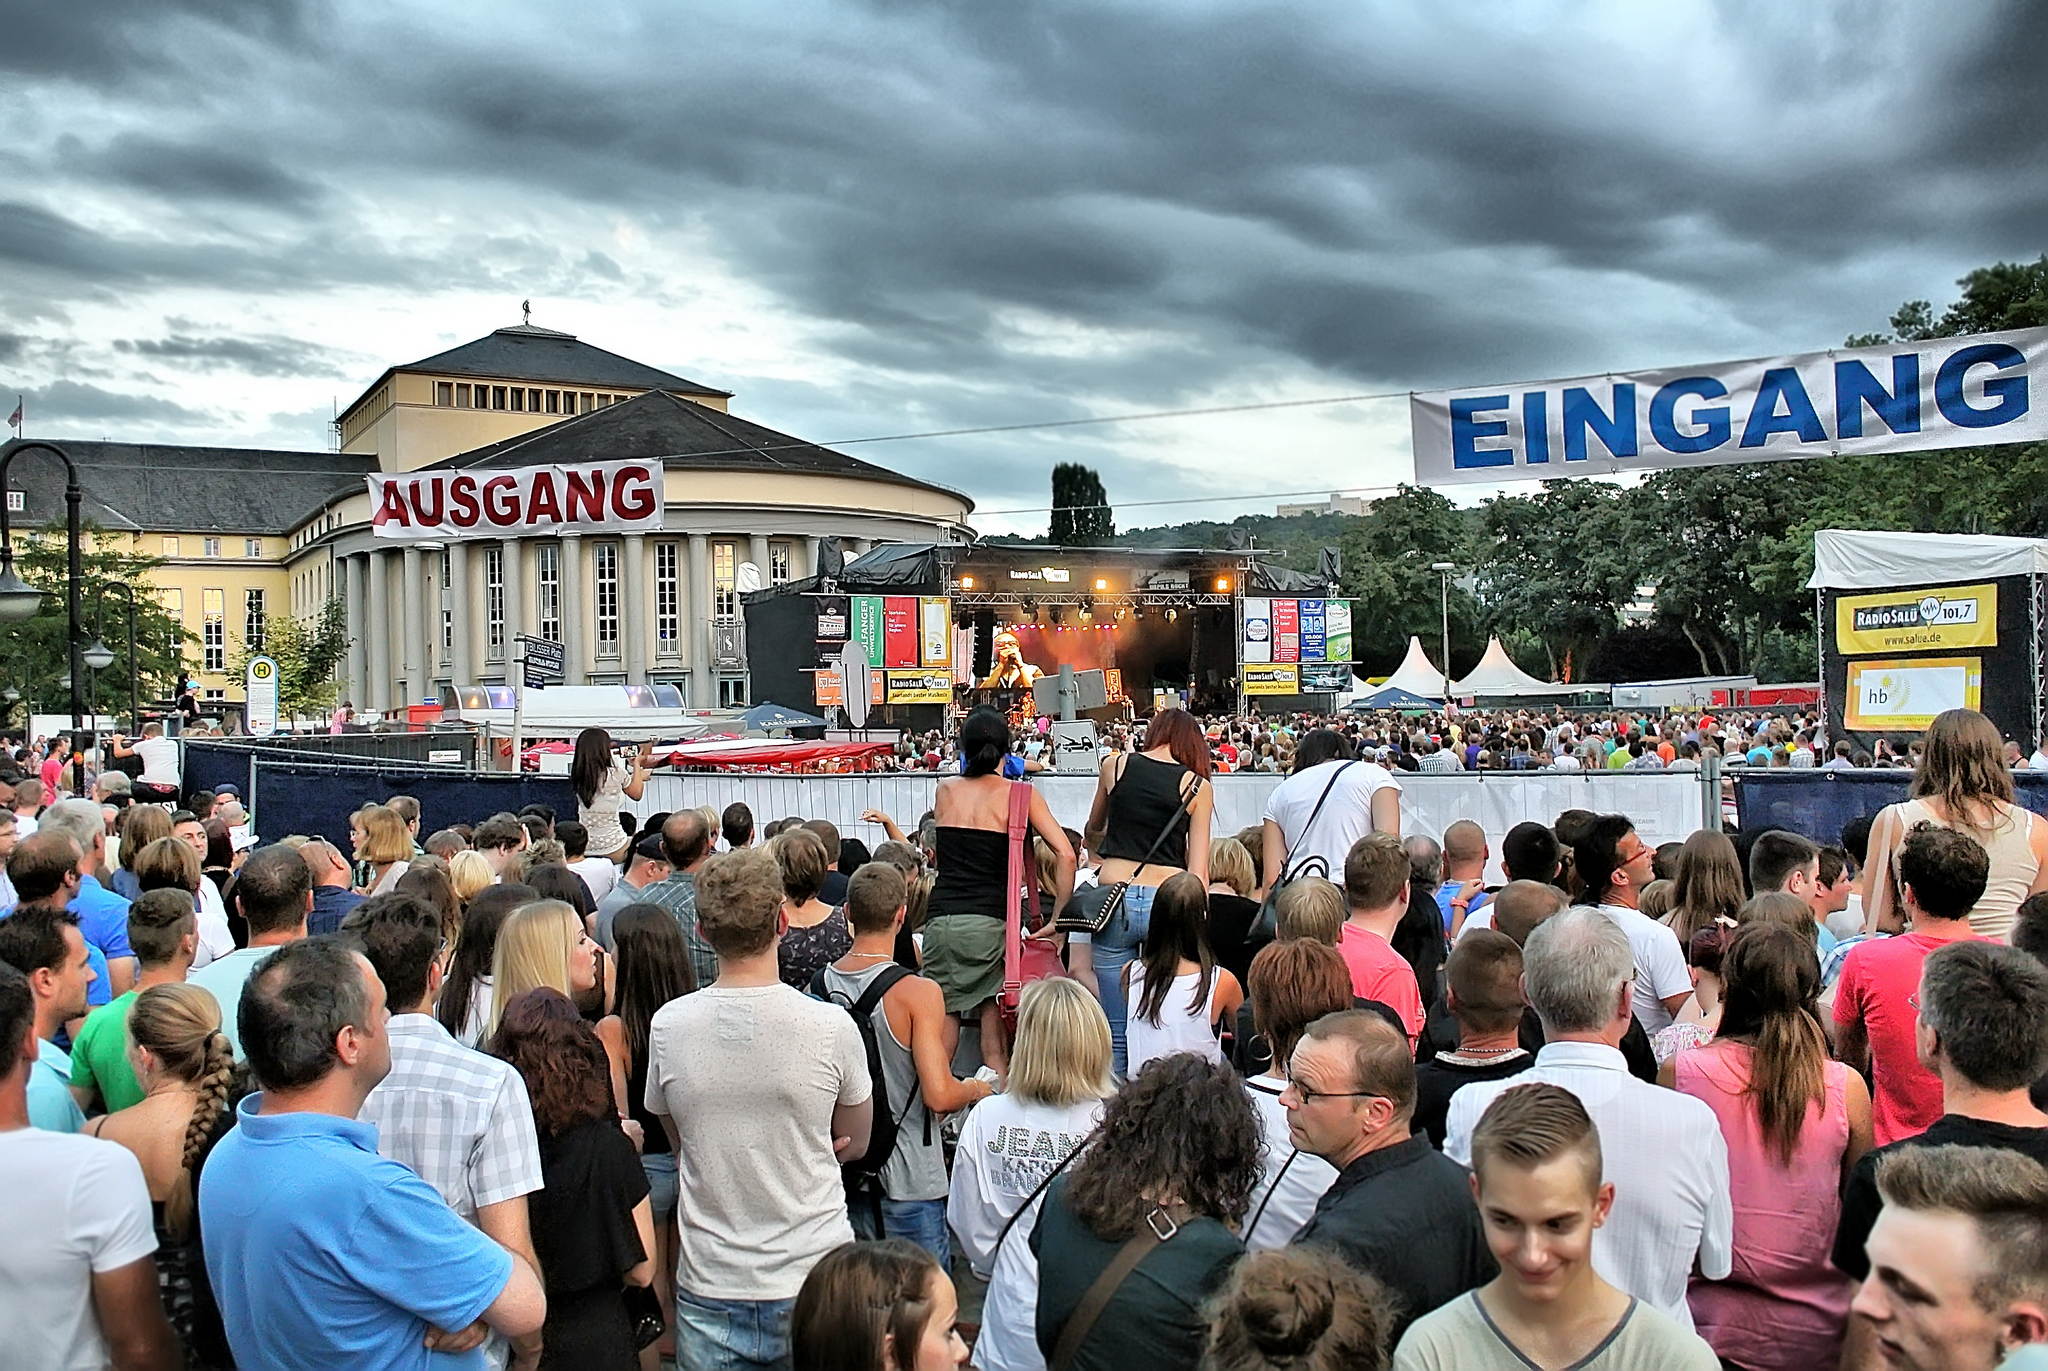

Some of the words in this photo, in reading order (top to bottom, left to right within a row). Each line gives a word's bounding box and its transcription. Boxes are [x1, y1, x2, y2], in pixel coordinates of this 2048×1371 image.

[1449, 343, 2030, 470] EINGANG
[372, 466, 656, 527] AUSGANG
[1943, 604, 1972, 620] 101,7
[1884, 632, 1941, 646] www.salue.de
[934, 643, 942, 655] hb
[257, 665, 267, 675] H
[1869, 688, 1888, 704] hb
